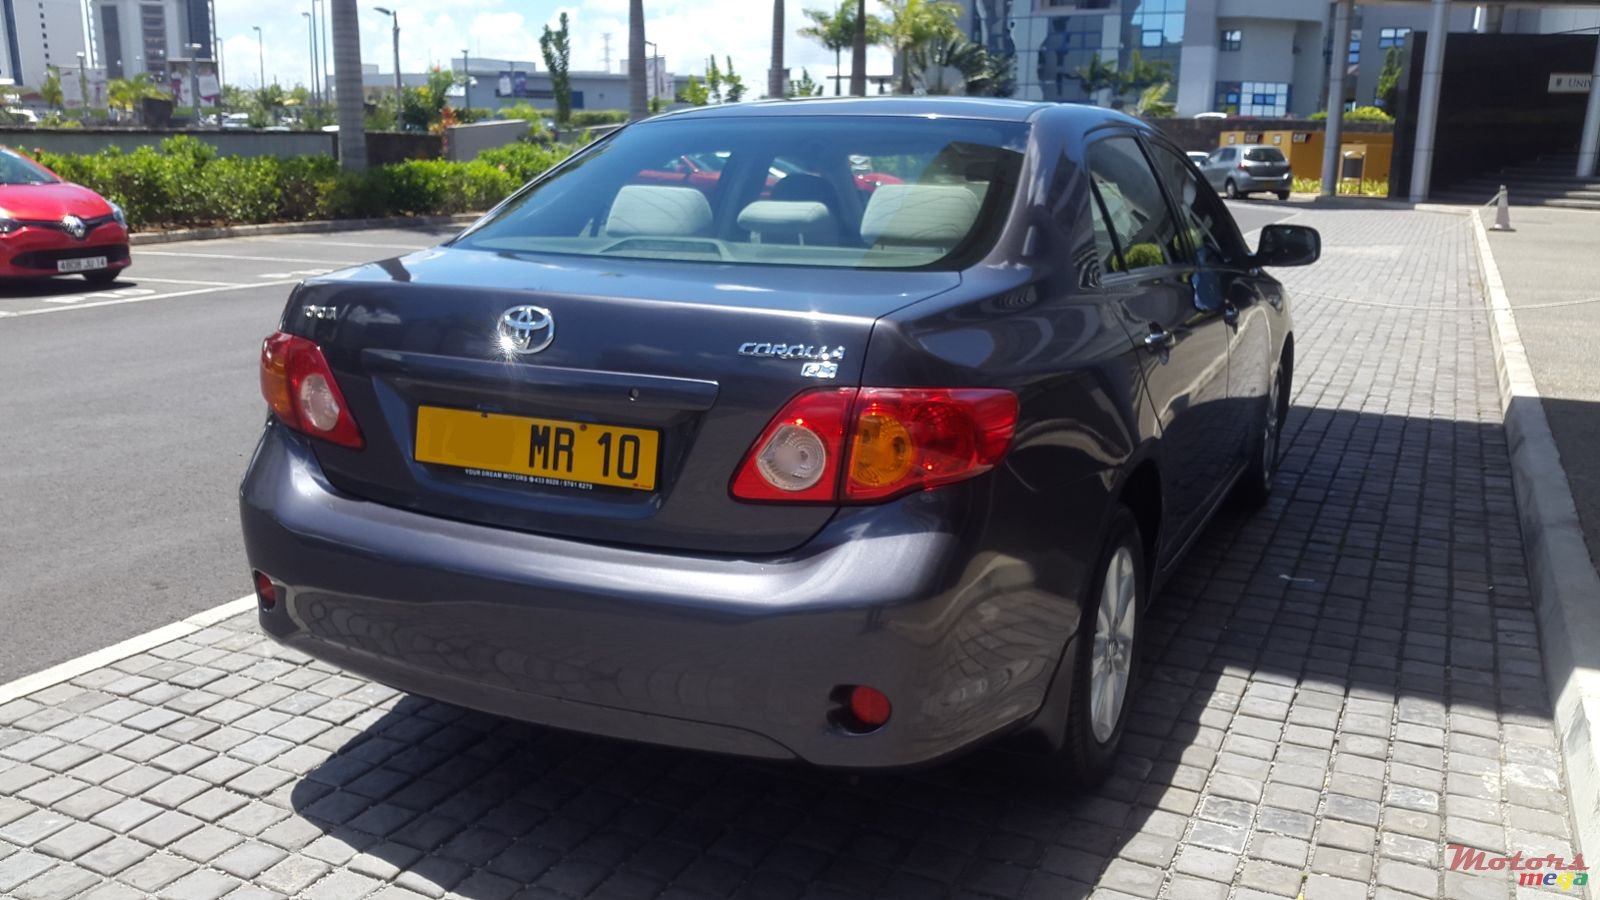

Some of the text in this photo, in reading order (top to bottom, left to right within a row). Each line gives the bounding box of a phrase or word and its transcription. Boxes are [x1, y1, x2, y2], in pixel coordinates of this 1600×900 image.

[738, 342, 845, 360] COROLLA
[528, 424, 641, 480] MR 10
[464, 468, 481, 476] YOUR
[481, 470, 502, 479] DREAM
[503, 472, 528, 482] MOTORS
